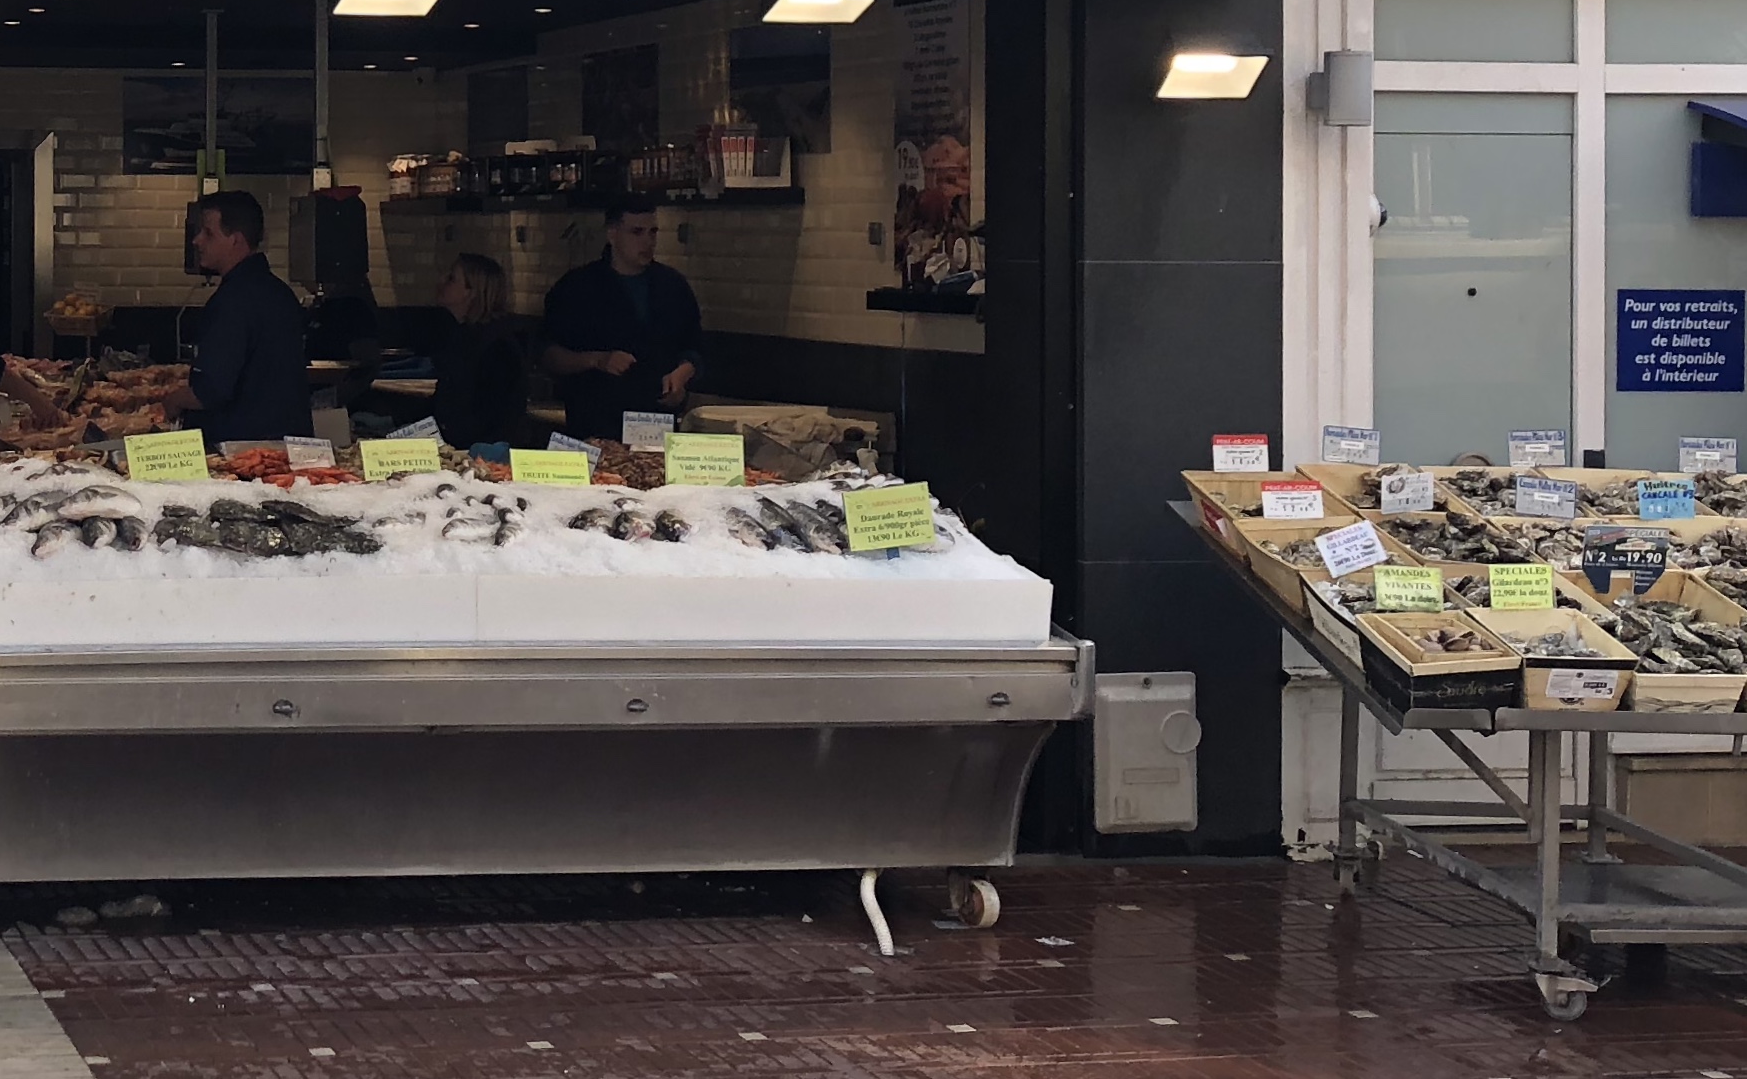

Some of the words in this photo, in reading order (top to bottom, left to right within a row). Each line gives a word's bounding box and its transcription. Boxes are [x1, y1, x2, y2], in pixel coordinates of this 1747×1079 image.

[1624, 298, 1656, 312] Pour
[1660, 303, 1681, 312] vos
[1685, 300, 1738, 314] retraits,
[1631, 319, 1647, 329] un
[1652, 316, 1731, 330] distributeur
[1651, 334, 1668, 347] de
[1672, 334, 1711, 347] billets
[1635, 353, 1656, 364] est
[1660, 351, 1726, 368] disponible
[1642, 368, 1651, 381] à
[1655, 368, 1719, 382] l'intérieur
[136, 453, 166, 462] TURBOT
[167, 450, 202, 460] SAUVAGE
[378, 459, 402, 467] BARS
[403, 458, 433, 466] PETITS
[860, 512, 895, 522] Daurade
[897, 508, 924, 519] Royale
[854, 526, 877, 534] Extra
[905, 530, 920, 538] KG
[1383, 569, 1431, 578] AMANDES
[1494, 567, 1547, 575] SPECIALES
[1385, 582, 1432, 590] VIVANTES
